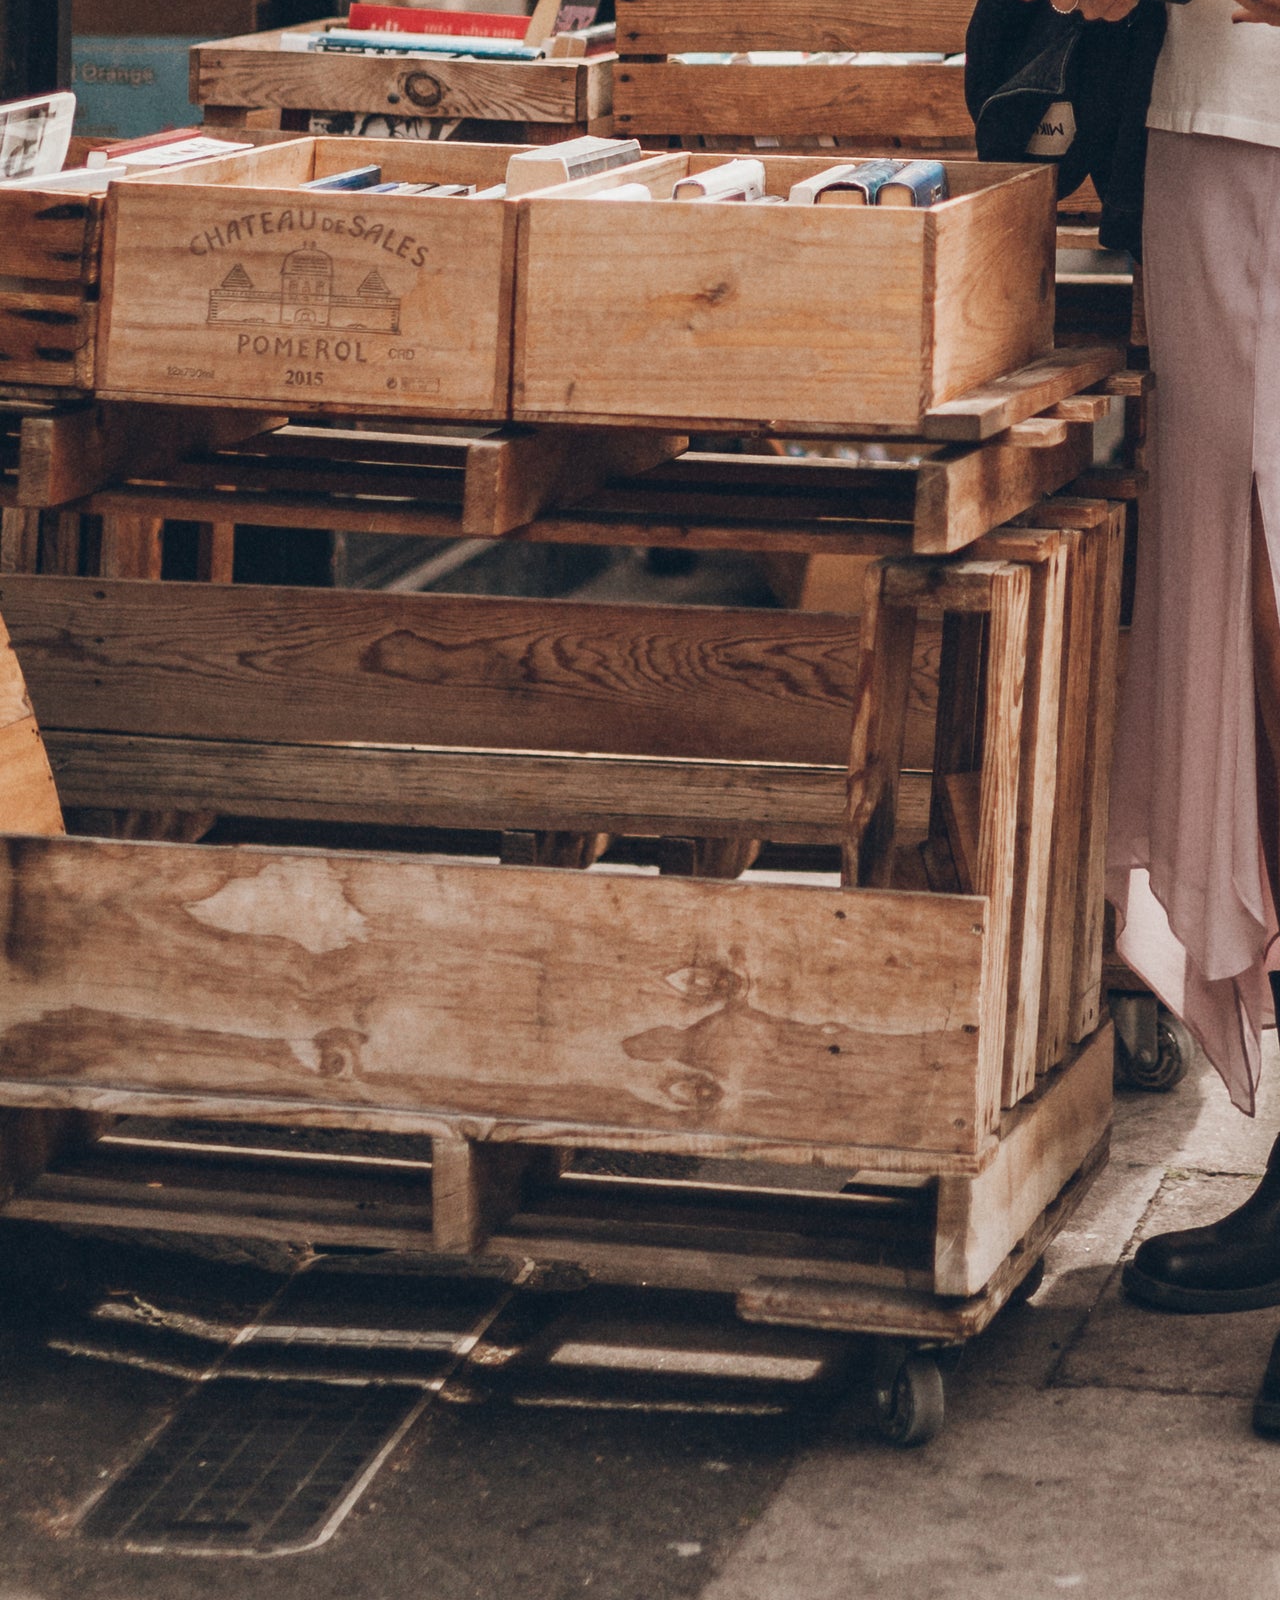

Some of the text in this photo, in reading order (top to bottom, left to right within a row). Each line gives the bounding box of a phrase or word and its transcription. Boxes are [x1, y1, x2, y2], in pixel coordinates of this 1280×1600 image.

[190, 210, 430, 268] CHATEAU DE SALES
[237, 333, 367, 363] POMEROL
[285, 369, 324, 386] 2015
